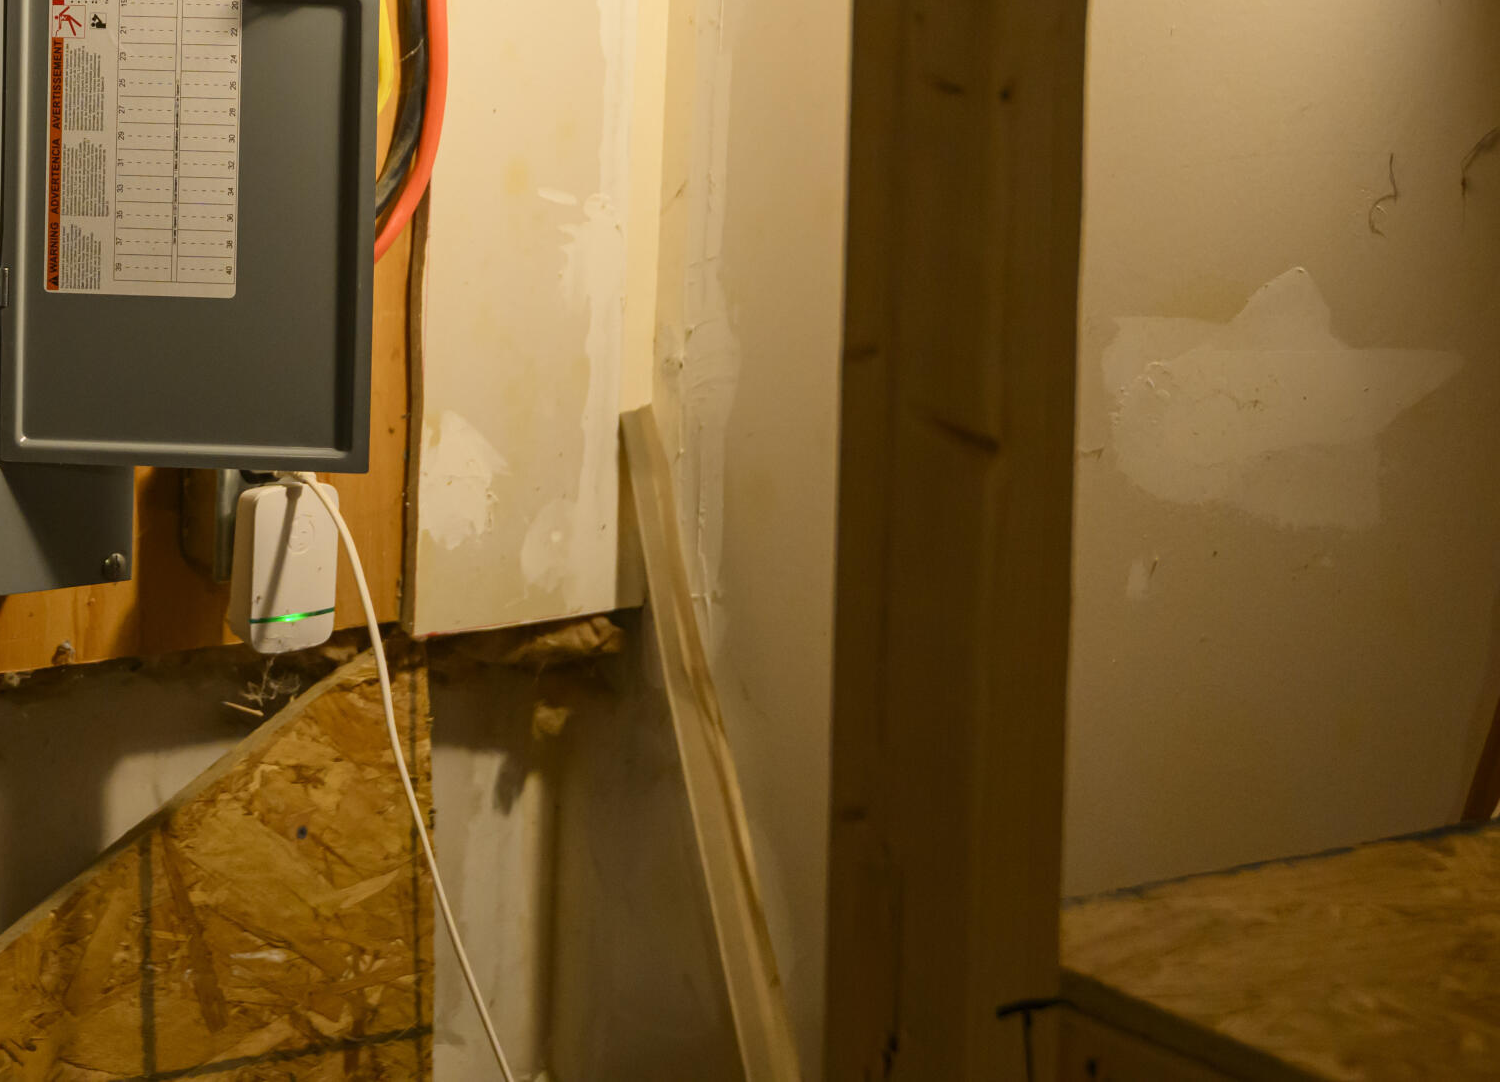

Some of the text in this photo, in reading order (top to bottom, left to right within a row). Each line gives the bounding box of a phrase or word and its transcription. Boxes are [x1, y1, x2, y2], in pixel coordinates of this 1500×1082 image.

[232, 0, 238, 10] 20
[120, 26, 126, 35] 21
[230, 27, 238, 37] 22
[119, 52, 126, 61] 23
[230, 54, 237, 64] 24
[52, 40, 62, 130] AVERTISSEMENT
[119, 78, 125, 88] 25
[118, 105, 125, 114] 27
[118, 131, 125, 141] 29
[229, 134, 235, 143] 30
[117, 158, 124, 167] 31
[228, 160, 234, 170] 32
[51, 138, 61, 215] ADVERTENCIA
[117, 184, 123, 193] 33
[227, 187, 234, 196] 34
[116, 210, 123, 219] 35
[227, 213, 233, 223] 36
[116, 237, 122, 246] 37
[226, 240, 233, 249] 38
[50, 222, 59, 273] WARNING
[115, 262, 122, 272] 39
[226, 265, 232, 275] 40
